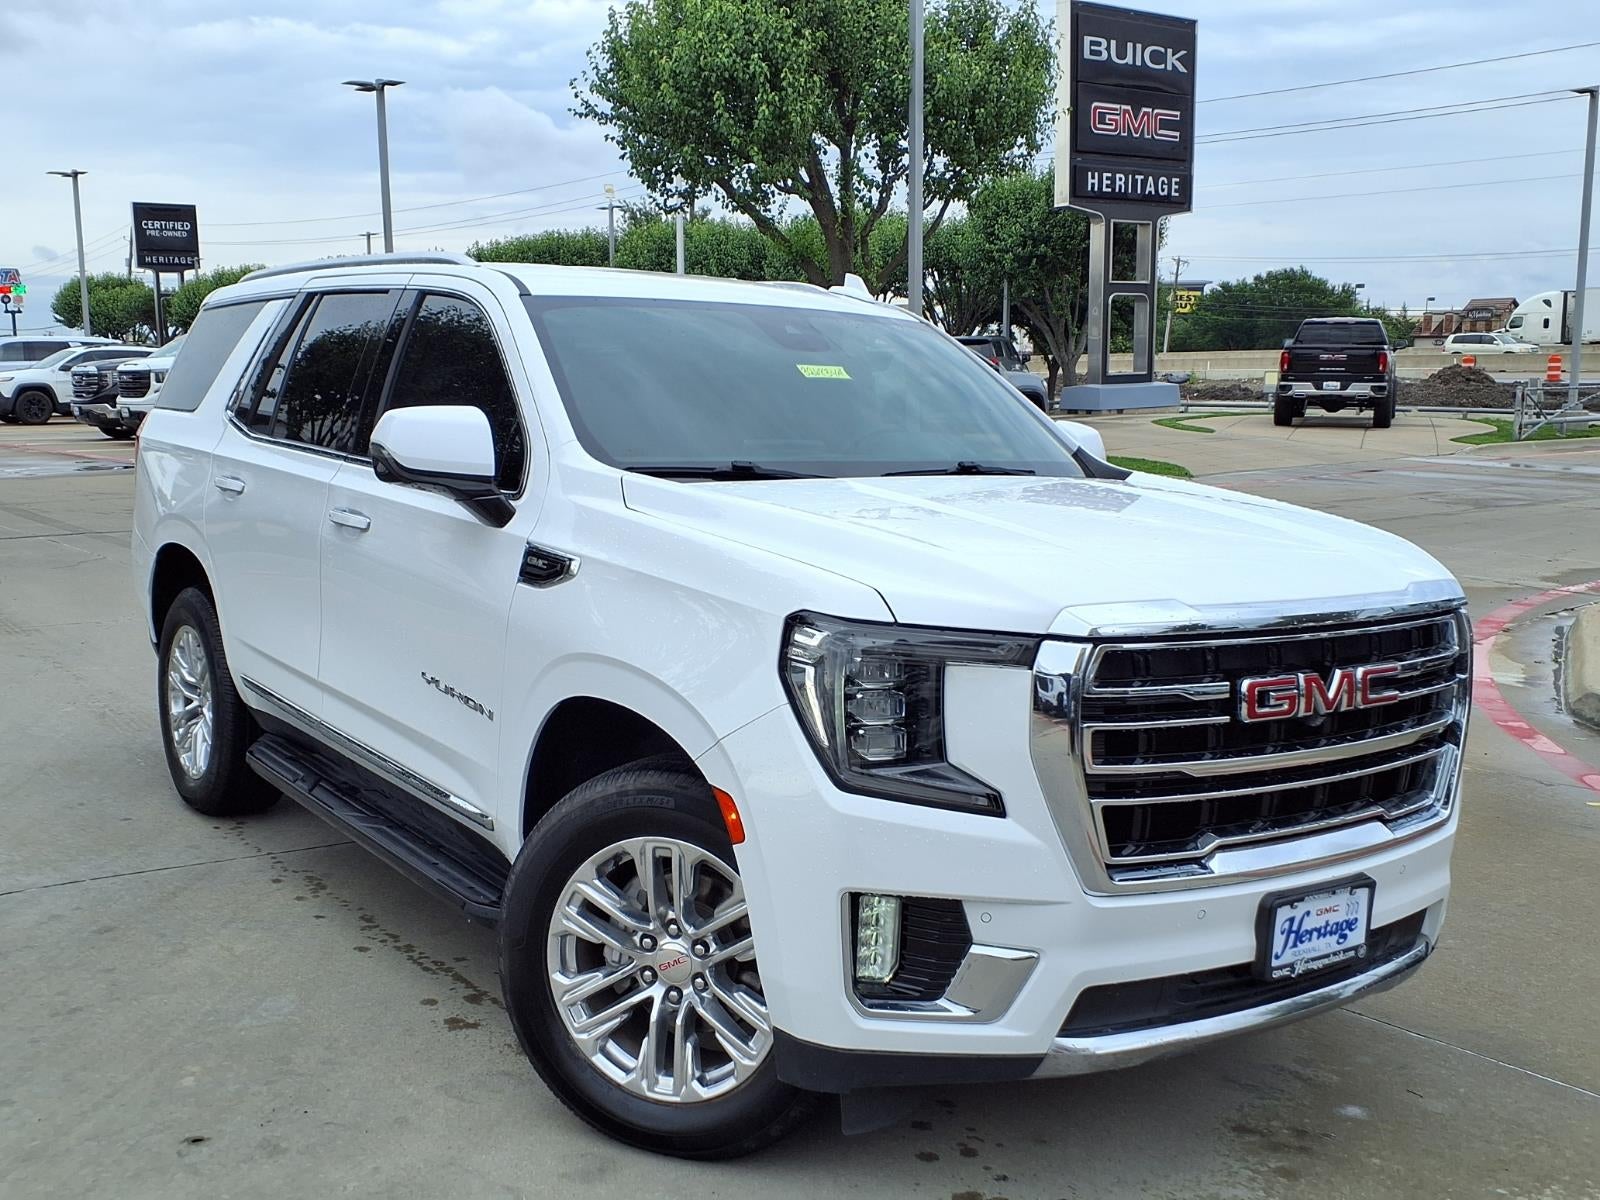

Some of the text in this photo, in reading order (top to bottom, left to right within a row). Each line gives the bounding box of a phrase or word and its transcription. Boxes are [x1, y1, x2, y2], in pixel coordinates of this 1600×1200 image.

[1083, 35, 1188, 73] BUICK
[1090, 101, 1181, 142] GMC
[1087, 171, 1180, 197] HERITAGE
[141, 220, 191, 230] CERTIFIED
[146, 229, 188, 238] PRE-OWNED
[145, 255, 193, 264] HERITAGE
[421, 671, 494, 722] YUKON
[1241, 664, 1400, 723] GMC
[1316, 905, 1340, 916] GMC
[1274, 910, 1359, 961] Heritage
[658, 956, 688, 972] GMC
